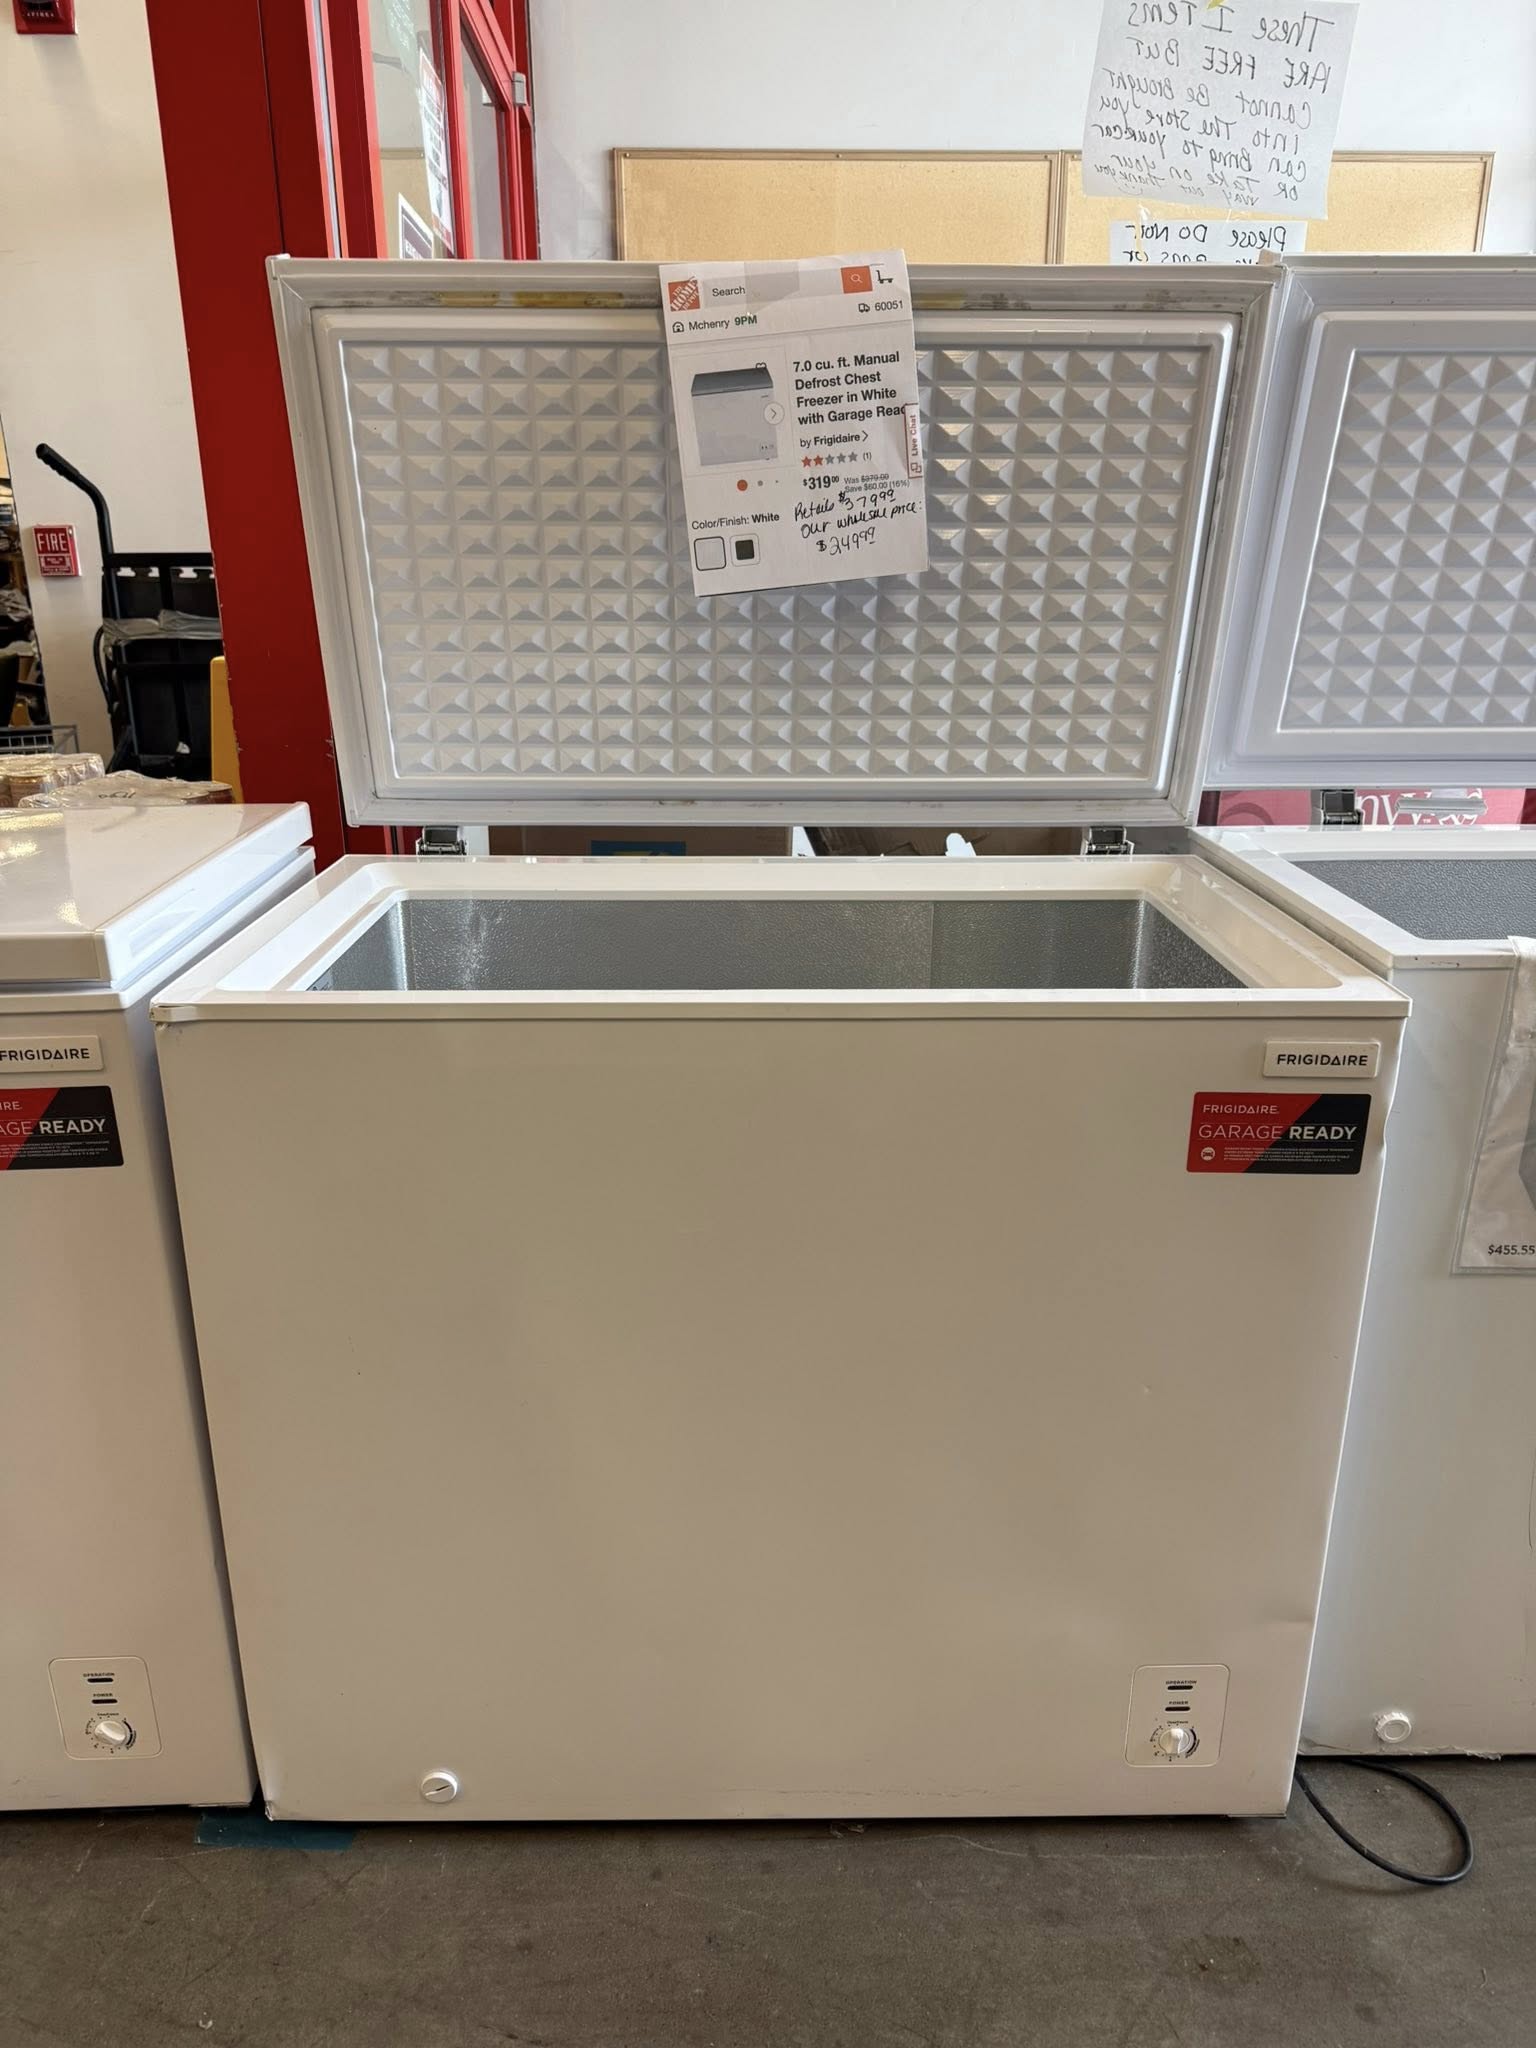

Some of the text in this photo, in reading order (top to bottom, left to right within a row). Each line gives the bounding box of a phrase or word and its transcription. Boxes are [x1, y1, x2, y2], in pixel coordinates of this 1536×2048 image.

[712, 286, 746, 297] Search
[874, 300, 903, 311] 60051
[688, 315, 758, 331] Mchenry 9PM
[793, 351, 900, 372] 7.0 cu. ft. Manual
[795, 371, 881, 390] Defrost Chest
[797, 388, 897, 408] Freezer in White
[798, 413, 824, 425] with
[828, 410, 873, 422] Garage
[909, 415, 917, 435] Chat
[800, 433, 860, 448] by Frigidaire
[863, 452, 872, 461] (1)
[845, 479, 910, 493] Save $60.00 (16%)
[691, 513, 780, 530] Color/Finish: White
[37, 533, 68, 552] FIRE
[1276, 1053, 1369, 1066] FRIGIDAIRE
[1202, 1104, 1279, 1115] FRIGIDAIRE
[39, 1119, 105, 1134] READY
[1199, 1124, 1357, 1140] GARAGE READY
[1488, 1244, 1536, 1256] $455.55
